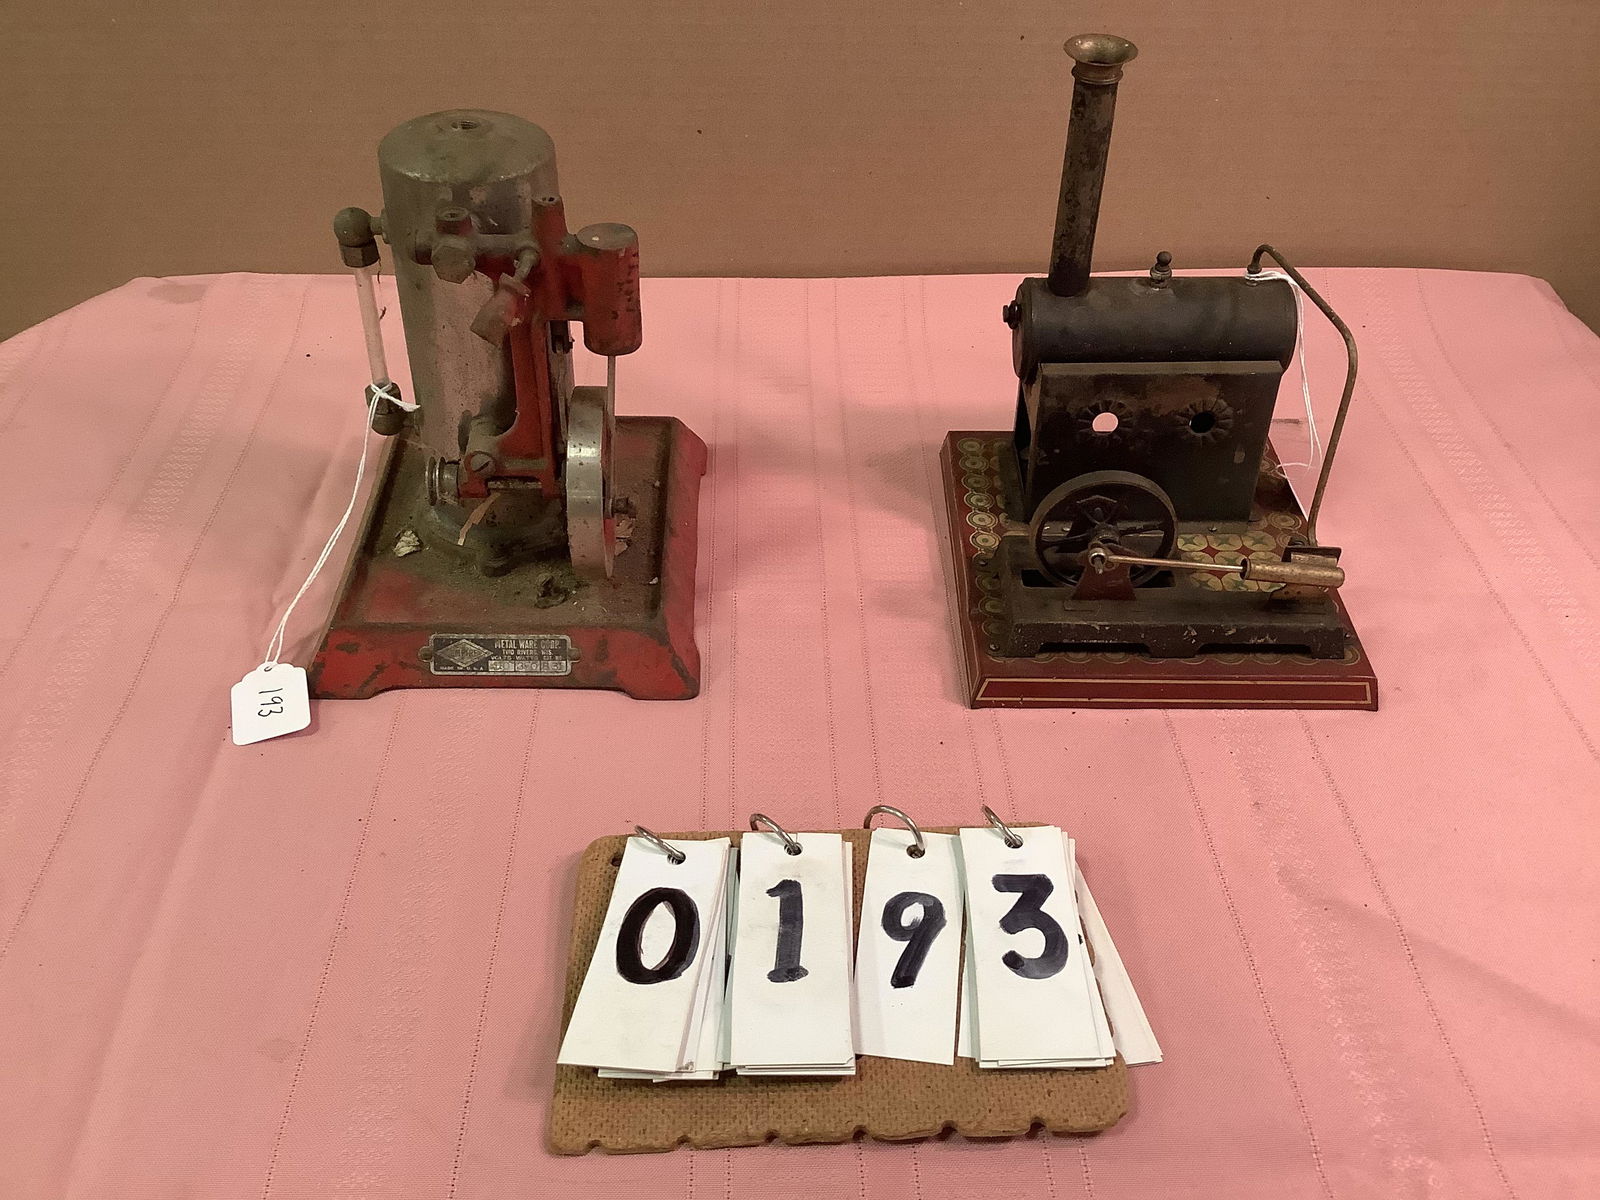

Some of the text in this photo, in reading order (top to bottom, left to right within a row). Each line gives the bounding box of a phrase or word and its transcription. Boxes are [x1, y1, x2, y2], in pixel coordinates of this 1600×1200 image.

[494, 639, 517, 649] METAL
[518, 639, 538, 649] WARE
[257, 688, 284, 718] 193
